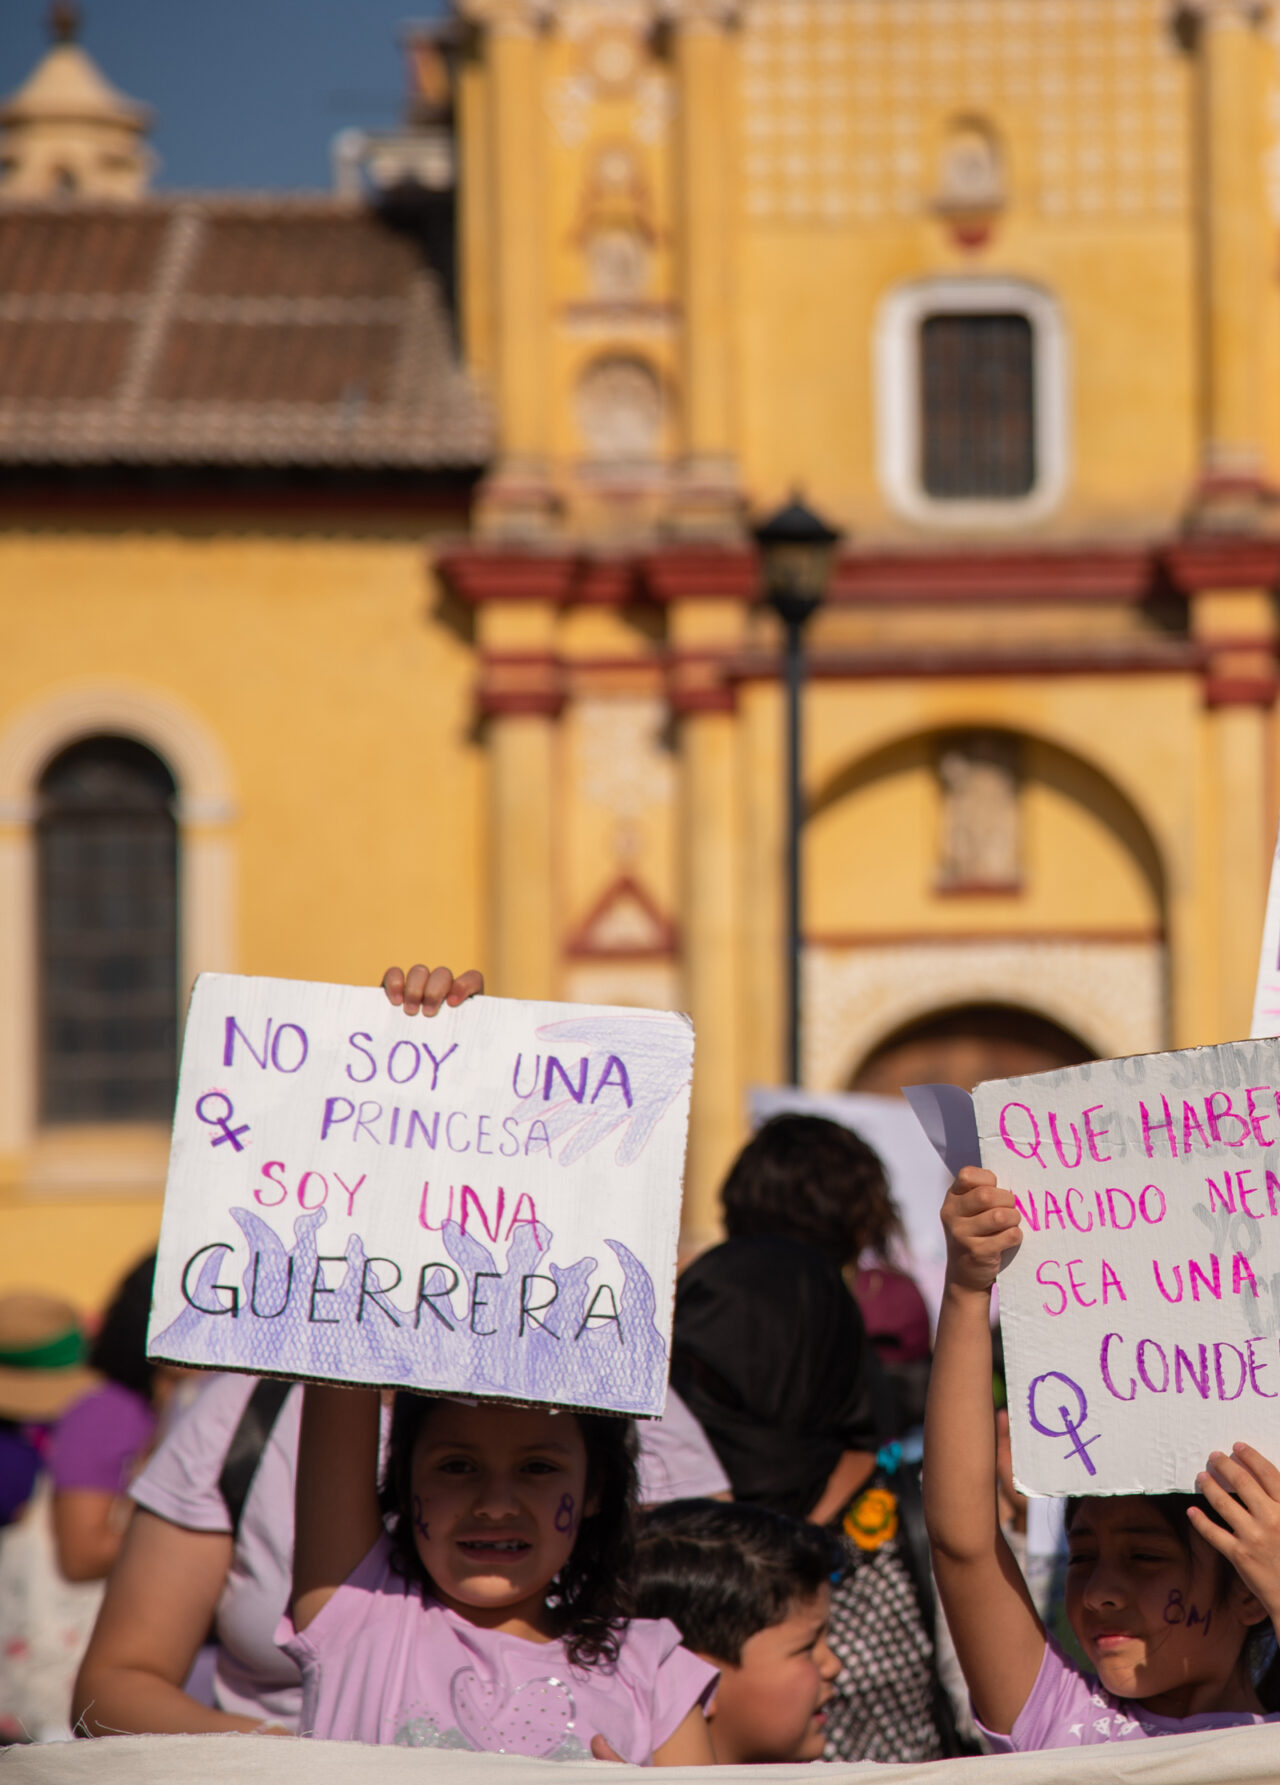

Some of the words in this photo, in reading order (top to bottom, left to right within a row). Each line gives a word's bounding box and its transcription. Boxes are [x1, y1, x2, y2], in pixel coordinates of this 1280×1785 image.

[223, 1016, 308, 1073] NO
[345, 1031, 458, 1091] SOY
[512, 1052, 633, 1109] UNA
[320, 1095, 552, 1159] PRINCESA
[999, 1101, 1111, 1169] QUE
[253, 1160, 366, 1216] SOY
[419, 1181, 544, 1251] UNA
[1008, 1184, 1167, 1233] NACIDO
[181, 1243, 624, 1345] GUERRERA
[1035, 1259, 1127, 1317] SEA
[1153, 1251, 1261, 1304] UNA
[1163, 1588, 1212, 1637] 8M
